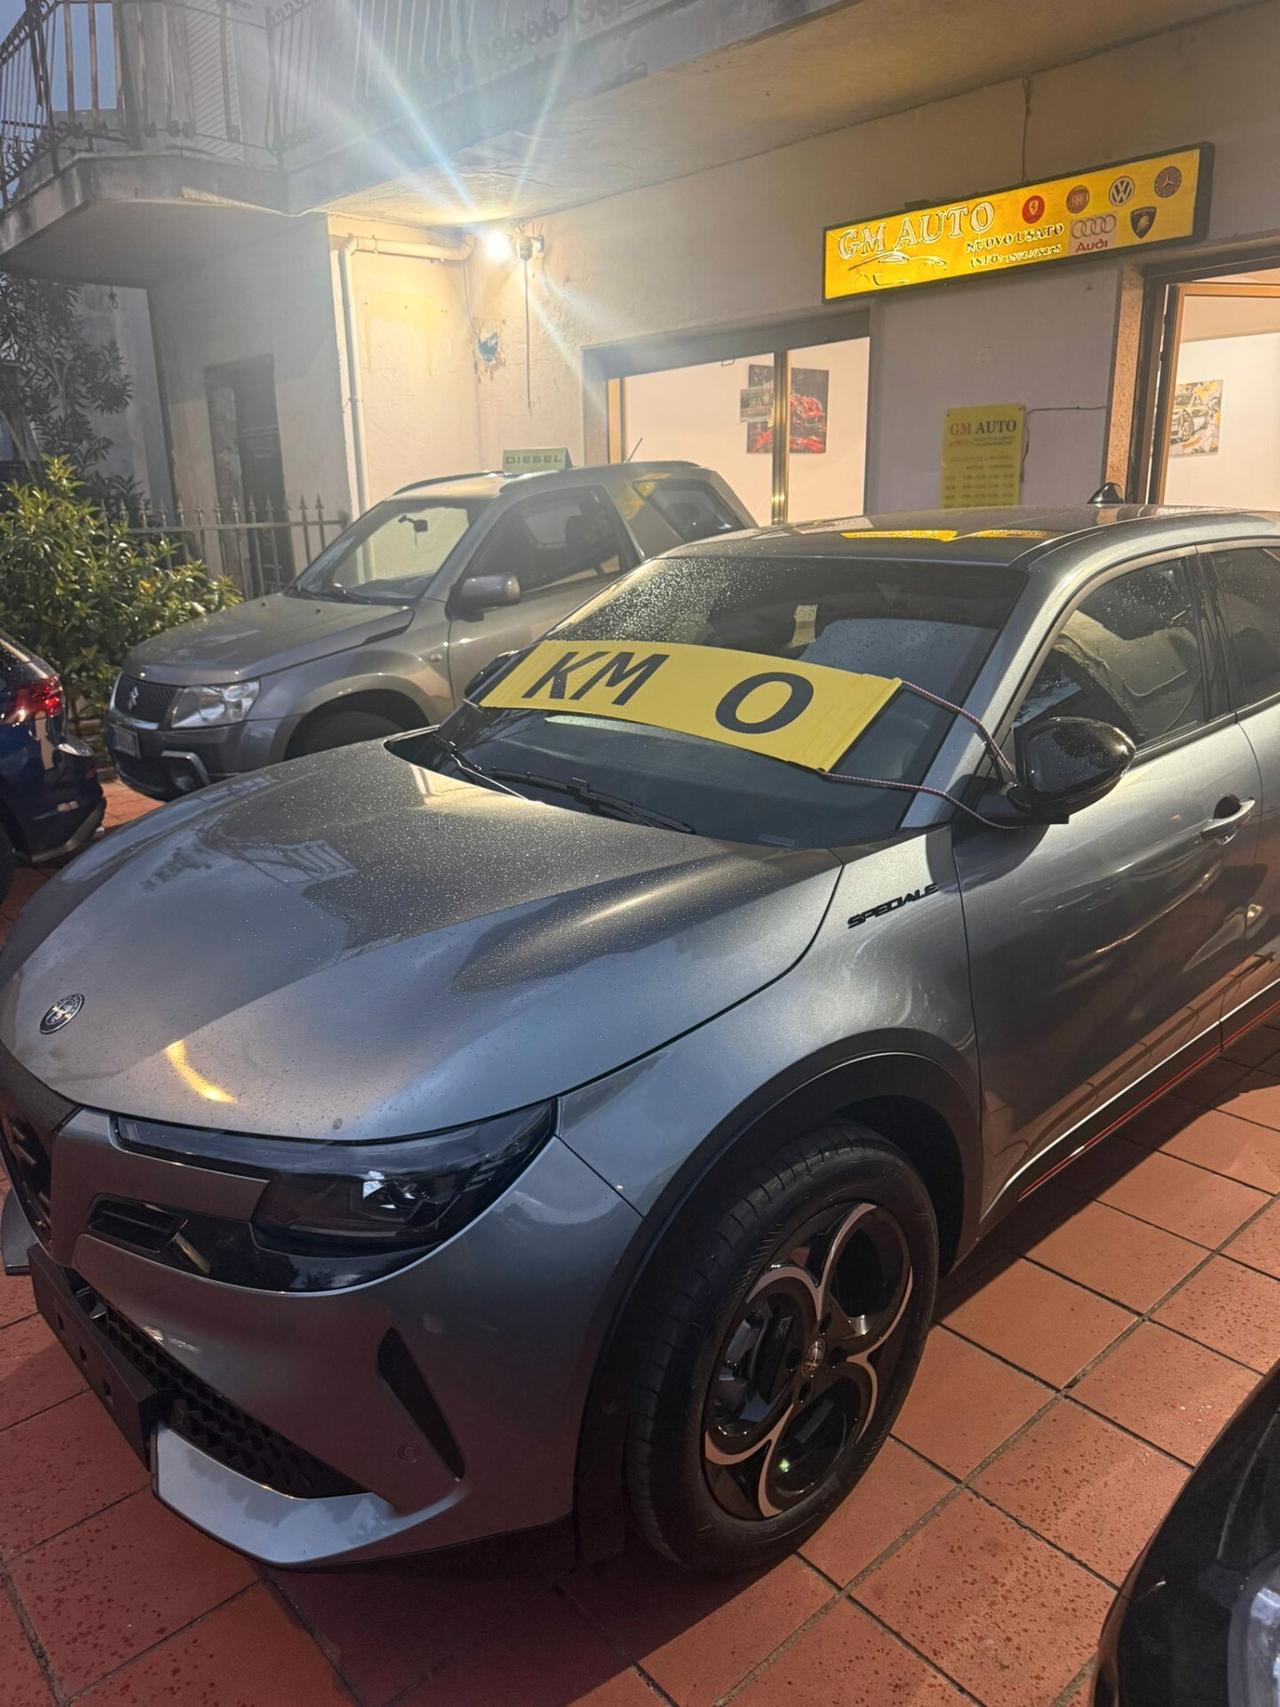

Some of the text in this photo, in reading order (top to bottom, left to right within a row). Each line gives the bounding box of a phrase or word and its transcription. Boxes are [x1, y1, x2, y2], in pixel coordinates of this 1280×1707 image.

[838, 201, 995, 260] GM AUTO
[966, 223, 1065, 253] NUOVO USATO
[1075, 238, 1108, 253] Audi
[950, 419, 1017, 436] GM AUTO
[505, 454, 562, 465] DIESEL
[522, 651, 671, 706] KM
[847, 882, 940, 929] SPECIALE
